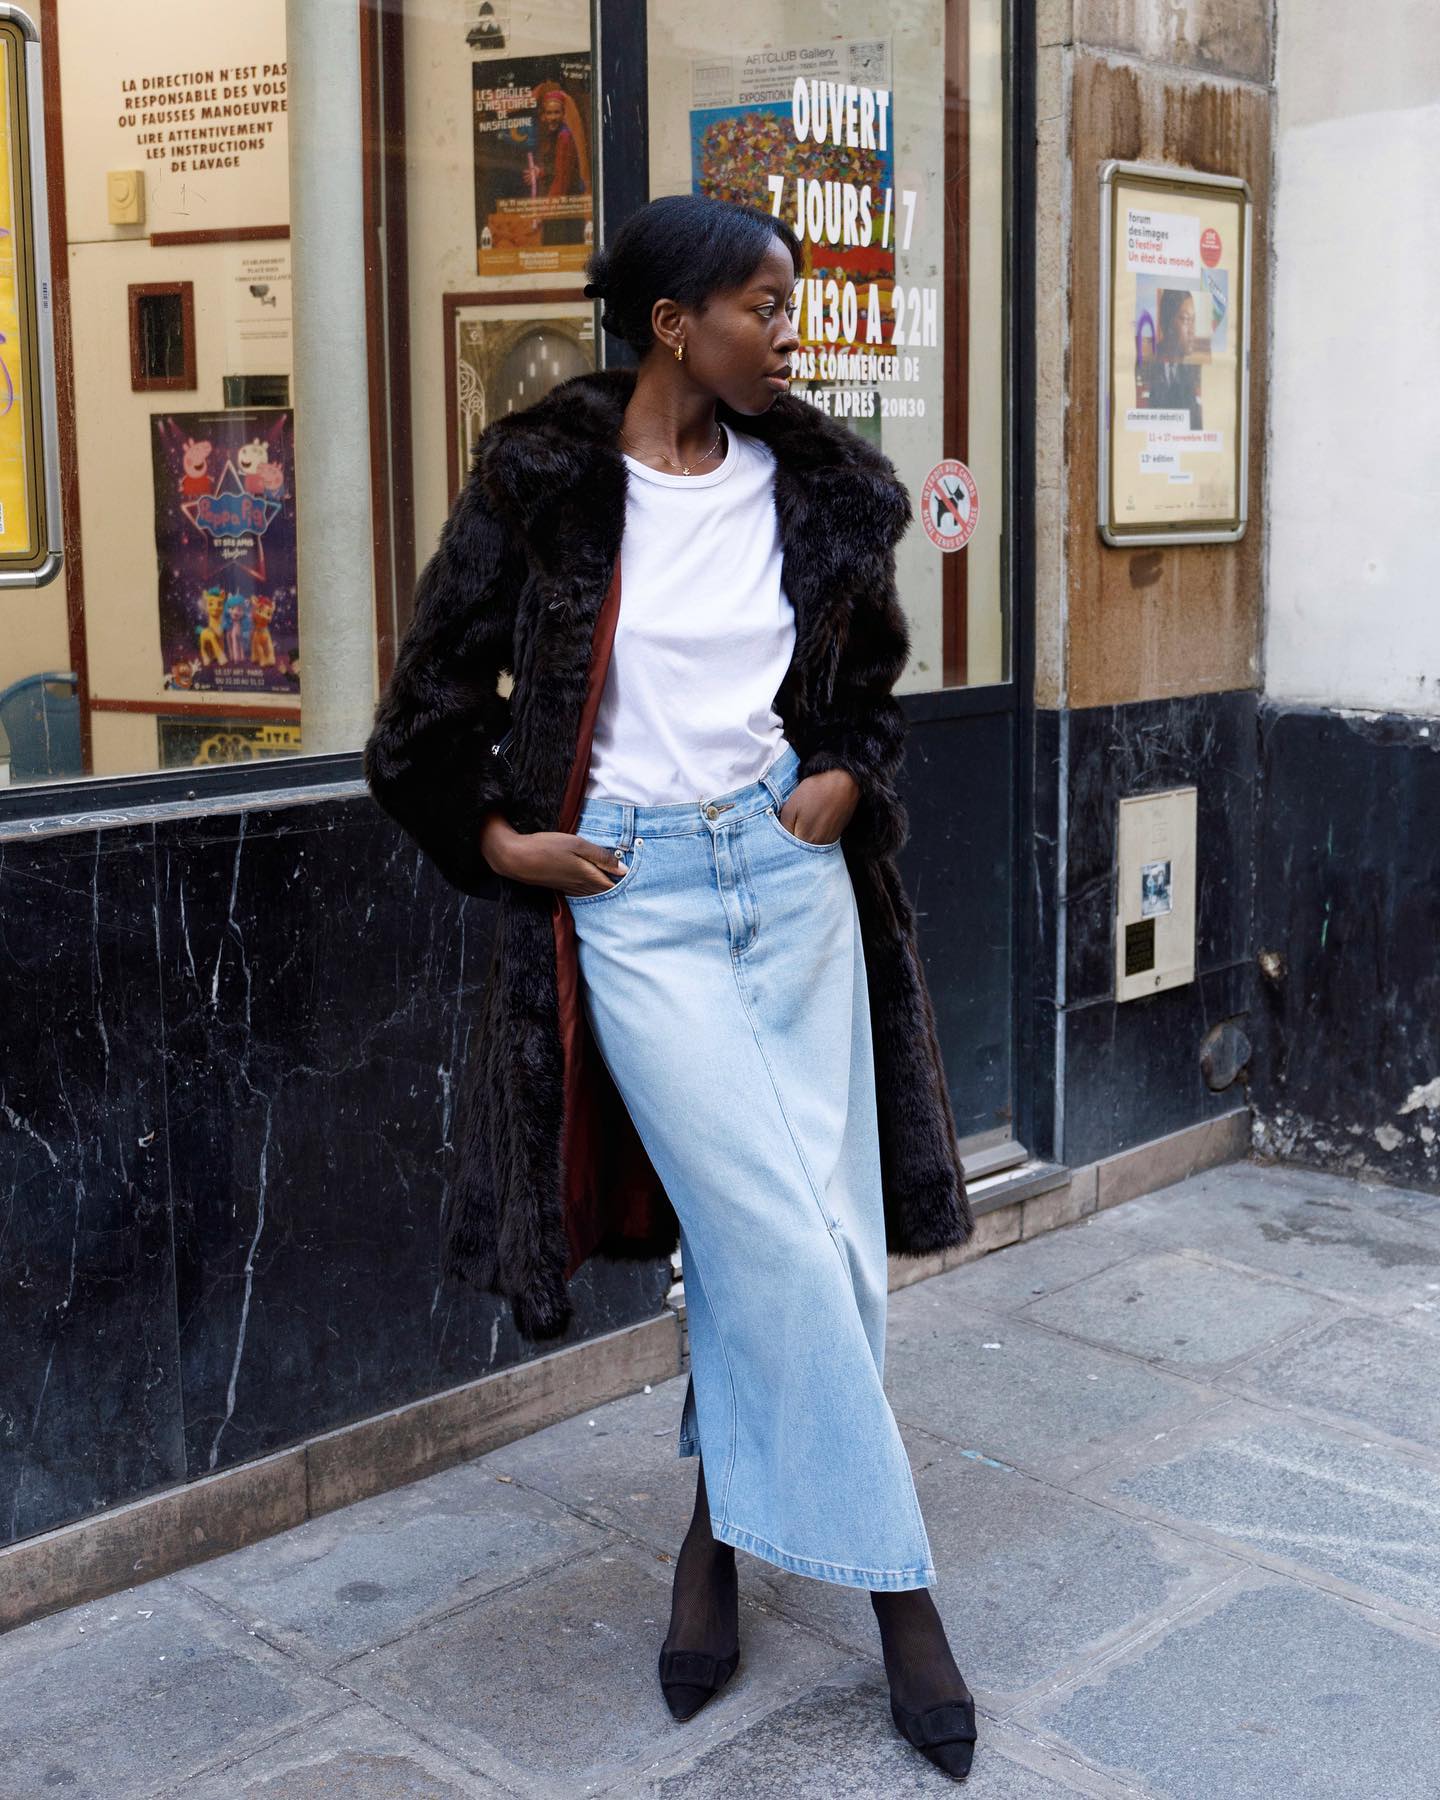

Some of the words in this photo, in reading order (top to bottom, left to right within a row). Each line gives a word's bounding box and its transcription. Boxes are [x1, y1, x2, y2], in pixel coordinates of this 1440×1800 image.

[746, 50, 797, 65] ARTCLUB
[800, 48, 835, 60] Gallery
[122, 80, 136, 92] LA
[142, 71, 214, 90] DIRECTION
[263, 62, 288, 77] PAS
[126, 89, 216, 109] RESPONSABLE
[224, 85, 247, 100] DES
[254, 82, 286, 96] VOLS
[476, 89, 493, 100] LES
[477, 98, 537, 112] D'HISTOIRES
[739, 90, 786, 103] EXPOSITION
[118, 115, 136, 128] OU
[142, 108, 195, 126] FAUSSES
[792, 76, 888, 151] OUVERT
[137, 132, 163, 145] LIRE
[168, 122, 273, 142] ATTENTIVEMENT
[146, 148, 166, 160] LES
[171, 138, 265, 157] INSTRUCTIONS
[171, 161, 186, 172] DE
[192, 156, 240, 171] LAVAGE
[768, 174, 784, 218] 7
[793, 178, 873, 248] JOURS
[902, 190, 917, 250] 7
[1128, 212, 1151, 224] forum
[1136, 240, 1162, 252] festival
[1128, 251, 1138, 262] Un
[1158, 255, 1168, 264] du
[1169, 257, 1194, 269] monde
[866, 283, 882, 344] A
[891, 286, 937, 348] 22H
[791, 352, 816, 379] PAS
[820, 353, 900, 382] COMMENCER
[904, 356, 920, 382] DE
[834, 392, 874, 418] APRES
[881, 398, 925, 418] 20H30
